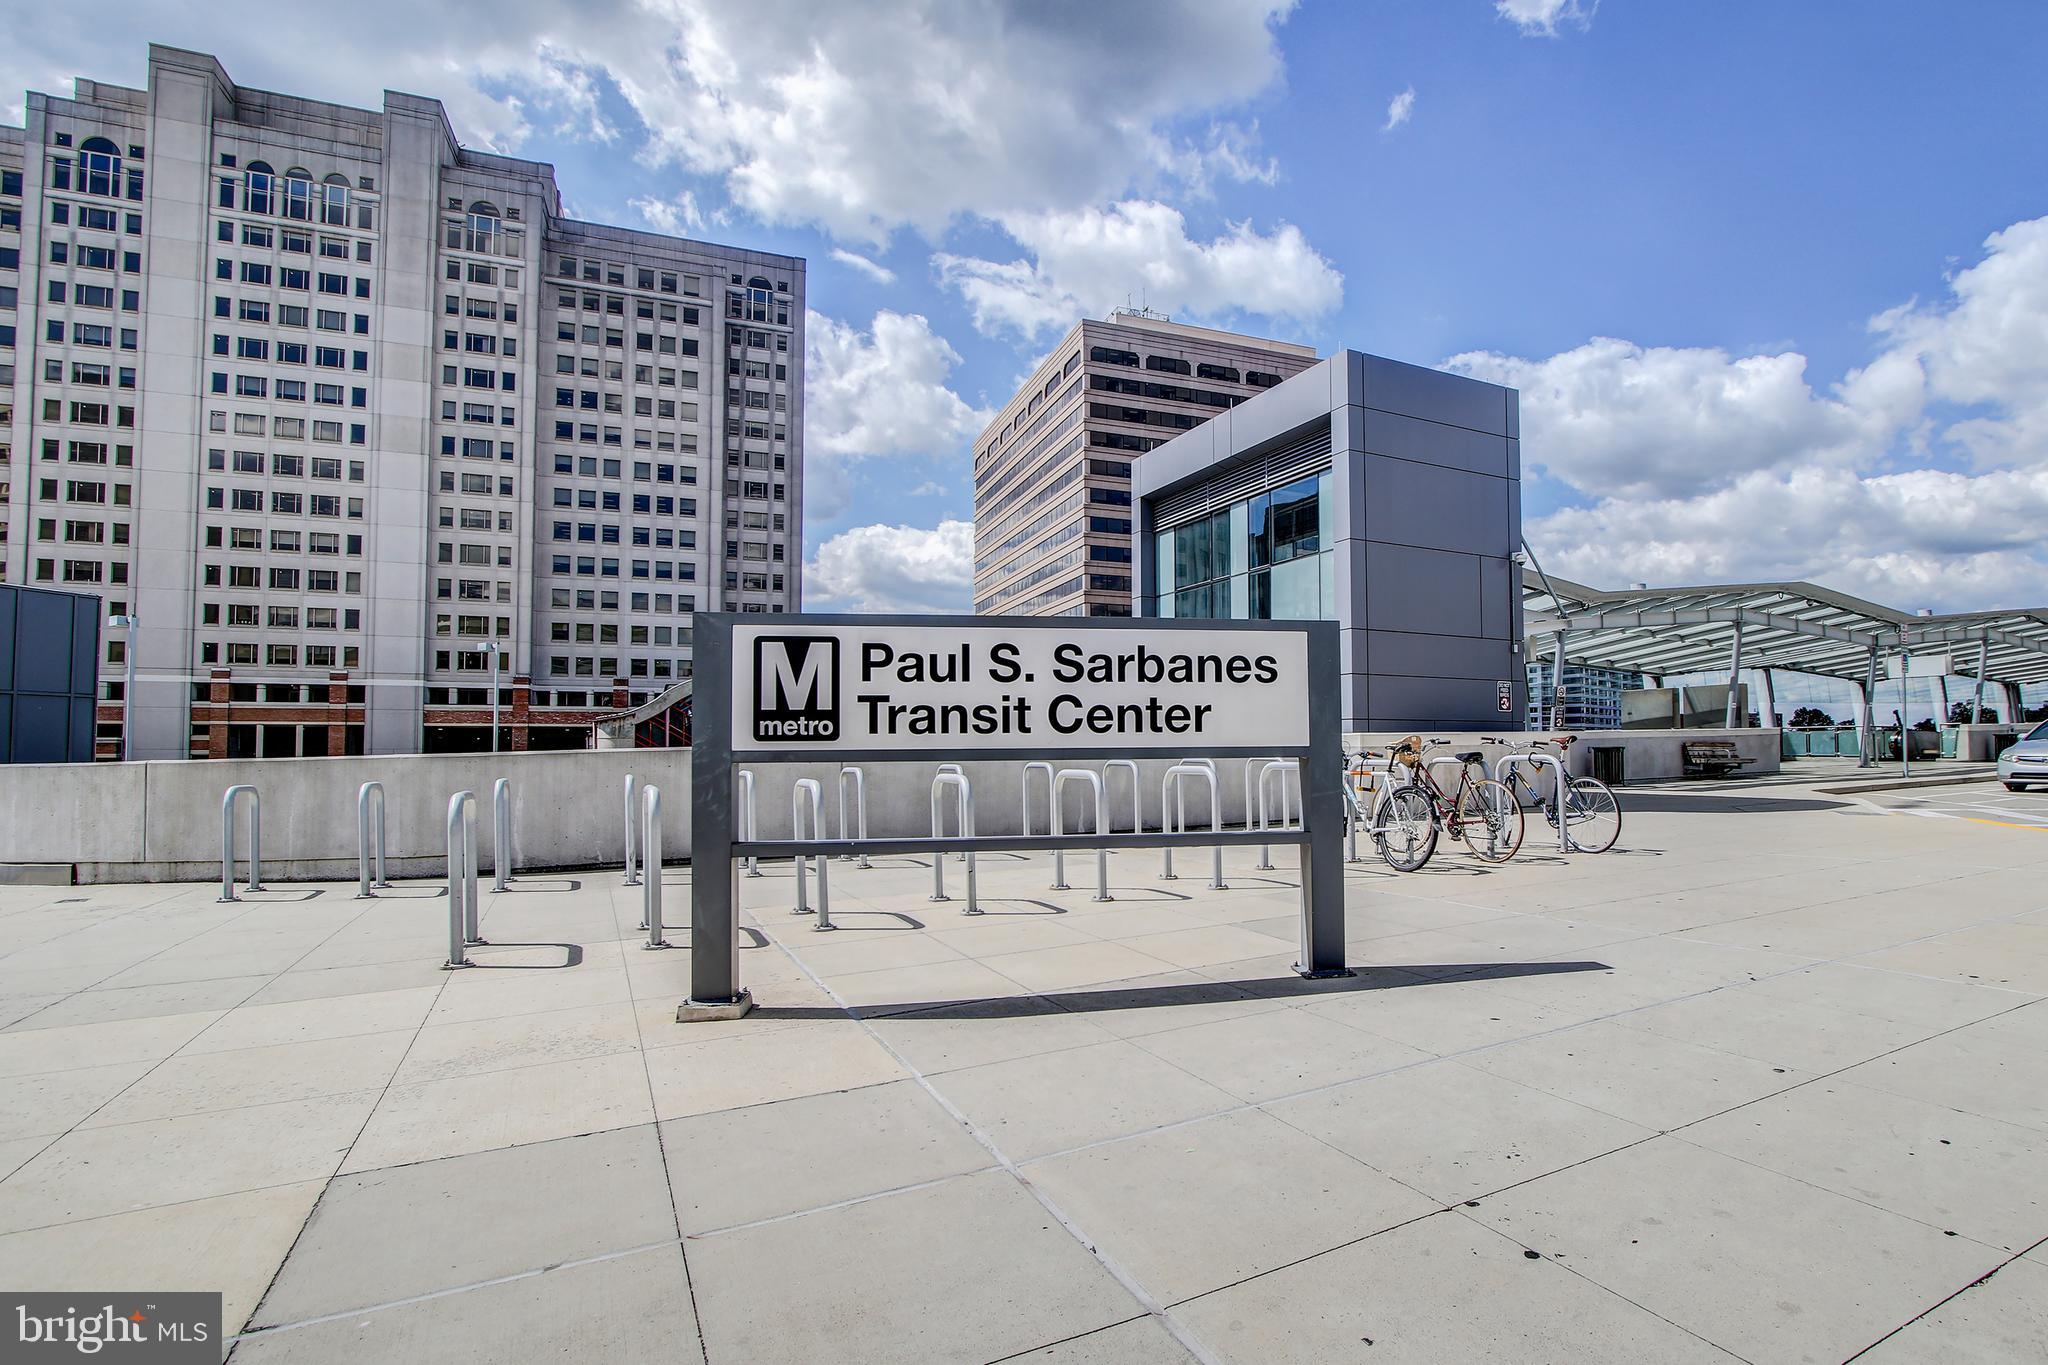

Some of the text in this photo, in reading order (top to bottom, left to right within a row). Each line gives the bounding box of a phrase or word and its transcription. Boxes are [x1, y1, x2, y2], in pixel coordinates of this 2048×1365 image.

[760, 641, 833, 711] M
[861, 642, 1279, 684] Paul S. Sarbanes
[759, 716, 834, 736] metro
[856, 693, 1212, 735] Transit Center
